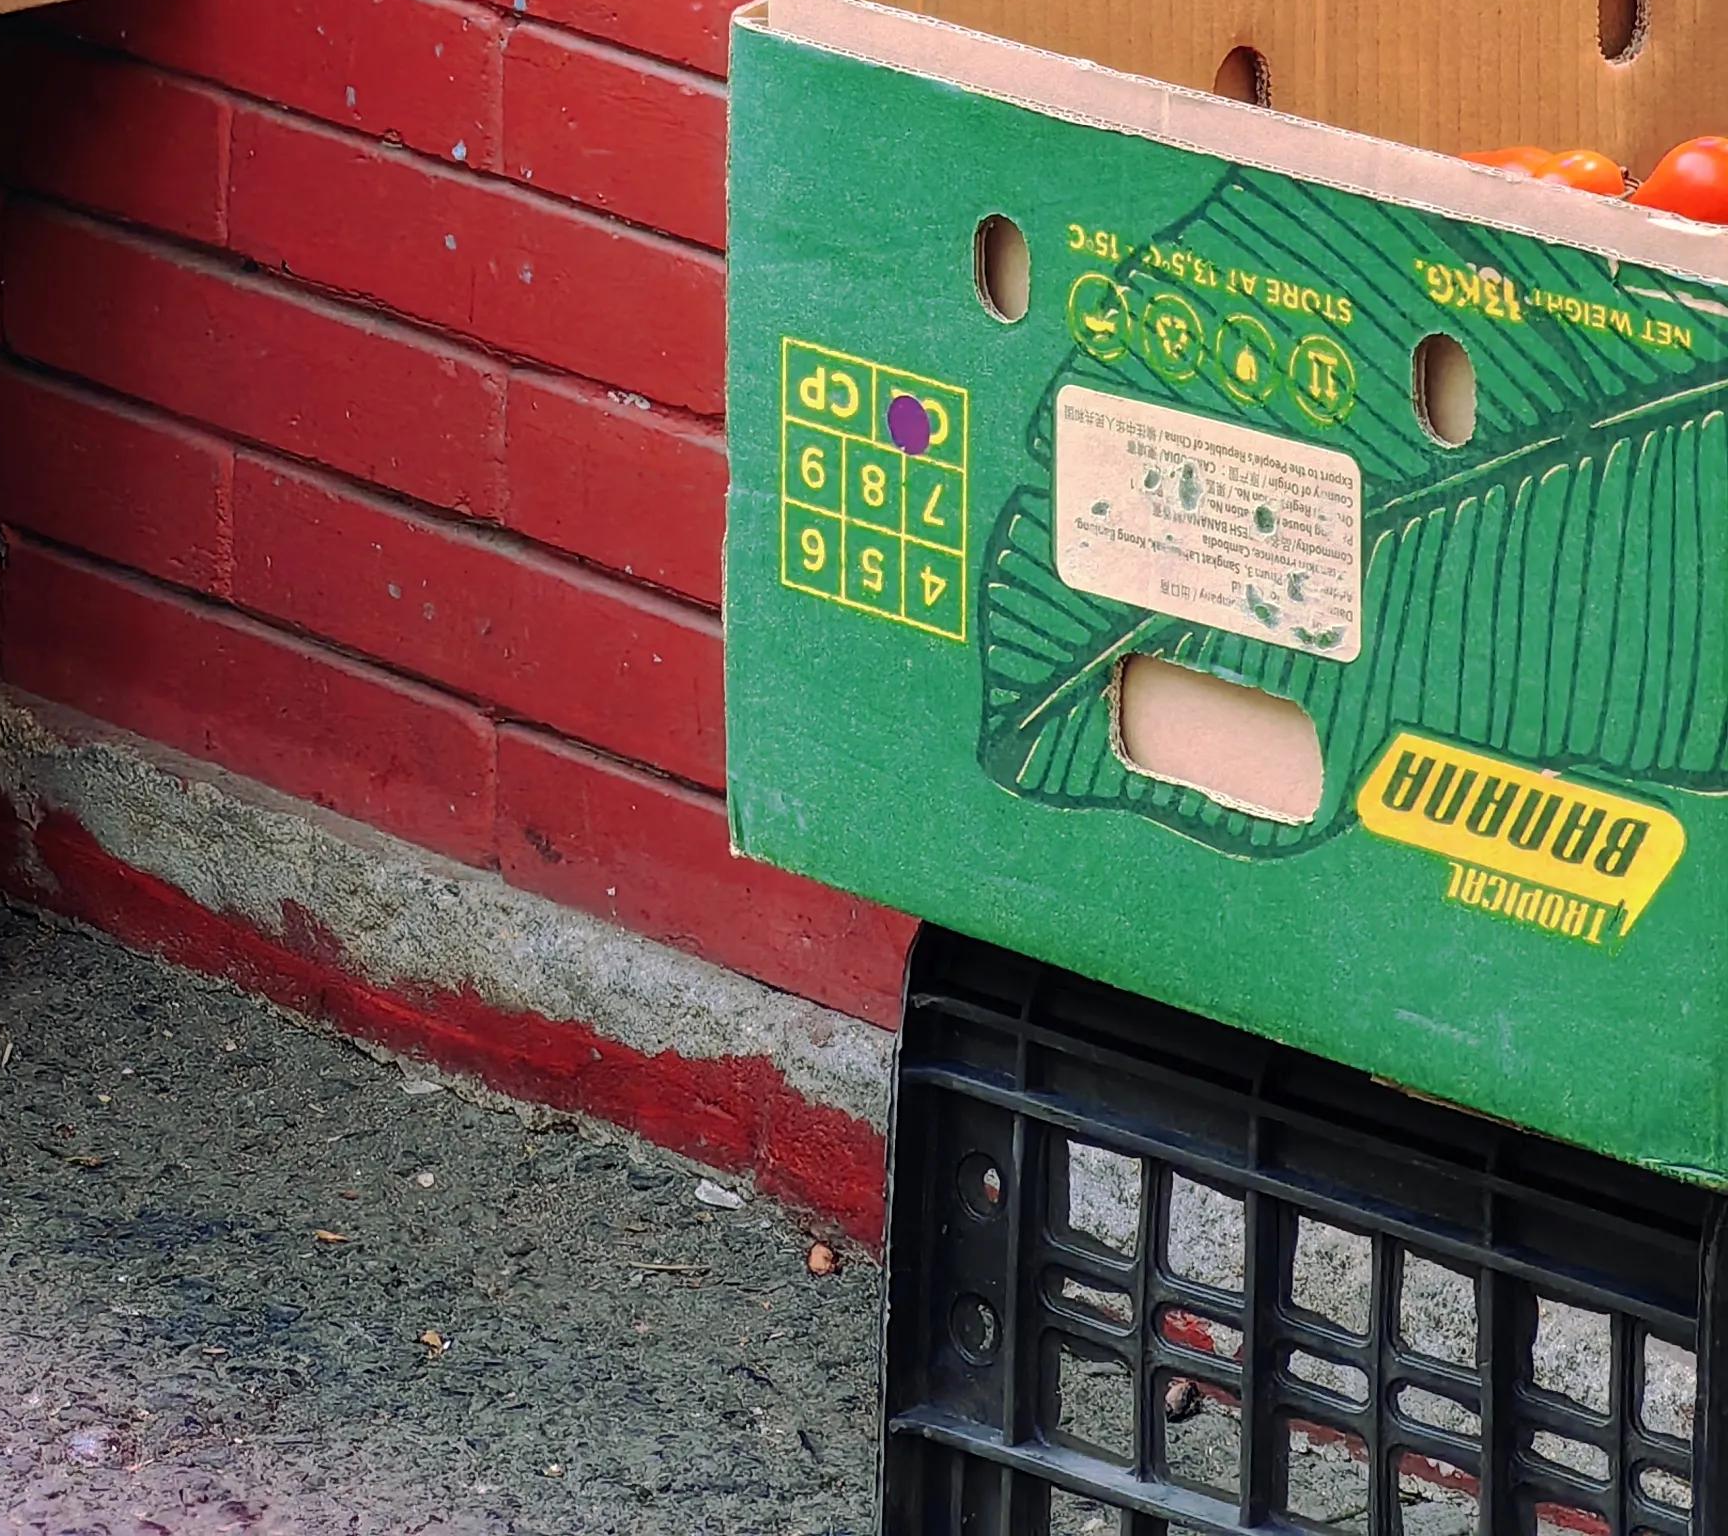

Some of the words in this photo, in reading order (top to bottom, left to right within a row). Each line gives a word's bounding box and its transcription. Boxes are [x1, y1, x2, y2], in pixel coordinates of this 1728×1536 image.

[1225, 268, 1258, 295] AT
[1265, 275, 1353, 323] STORE
[1641, 317, 1693, 349] NET
[799, 365, 859, 418] CP
[890, 388, 948, 446] C
[1165, 430, 1190, 448] China
[1204, 439, 1245, 462] Republic
[801, 446, 826, 489] 9
[1247, 450, 1287, 473] People's
[1290, 463, 1304, 478] the
[861, 464, 886, 506] 8
[1268, 474, 1298, 495] Origin
[1320, 469, 1353, 489] Export
[923, 483, 945, 526] 7
[1206, 497, 1222, 512] No.
[1234, 486, 1249, 501] No.
[1117, 527, 1145, 548] Krong
[1281, 517, 1311, 535] house
[800, 527, 826, 571] 6
[1202, 534, 1249, 557] Cambodia
[860, 547, 884, 592] 5
[1202, 551, 1239, 574] Sangkat
[920, 565, 947, 606] 4
[1382, 750, 1650, 879] BANANA
[1446, 862, 1607, 944] TROPICAL
